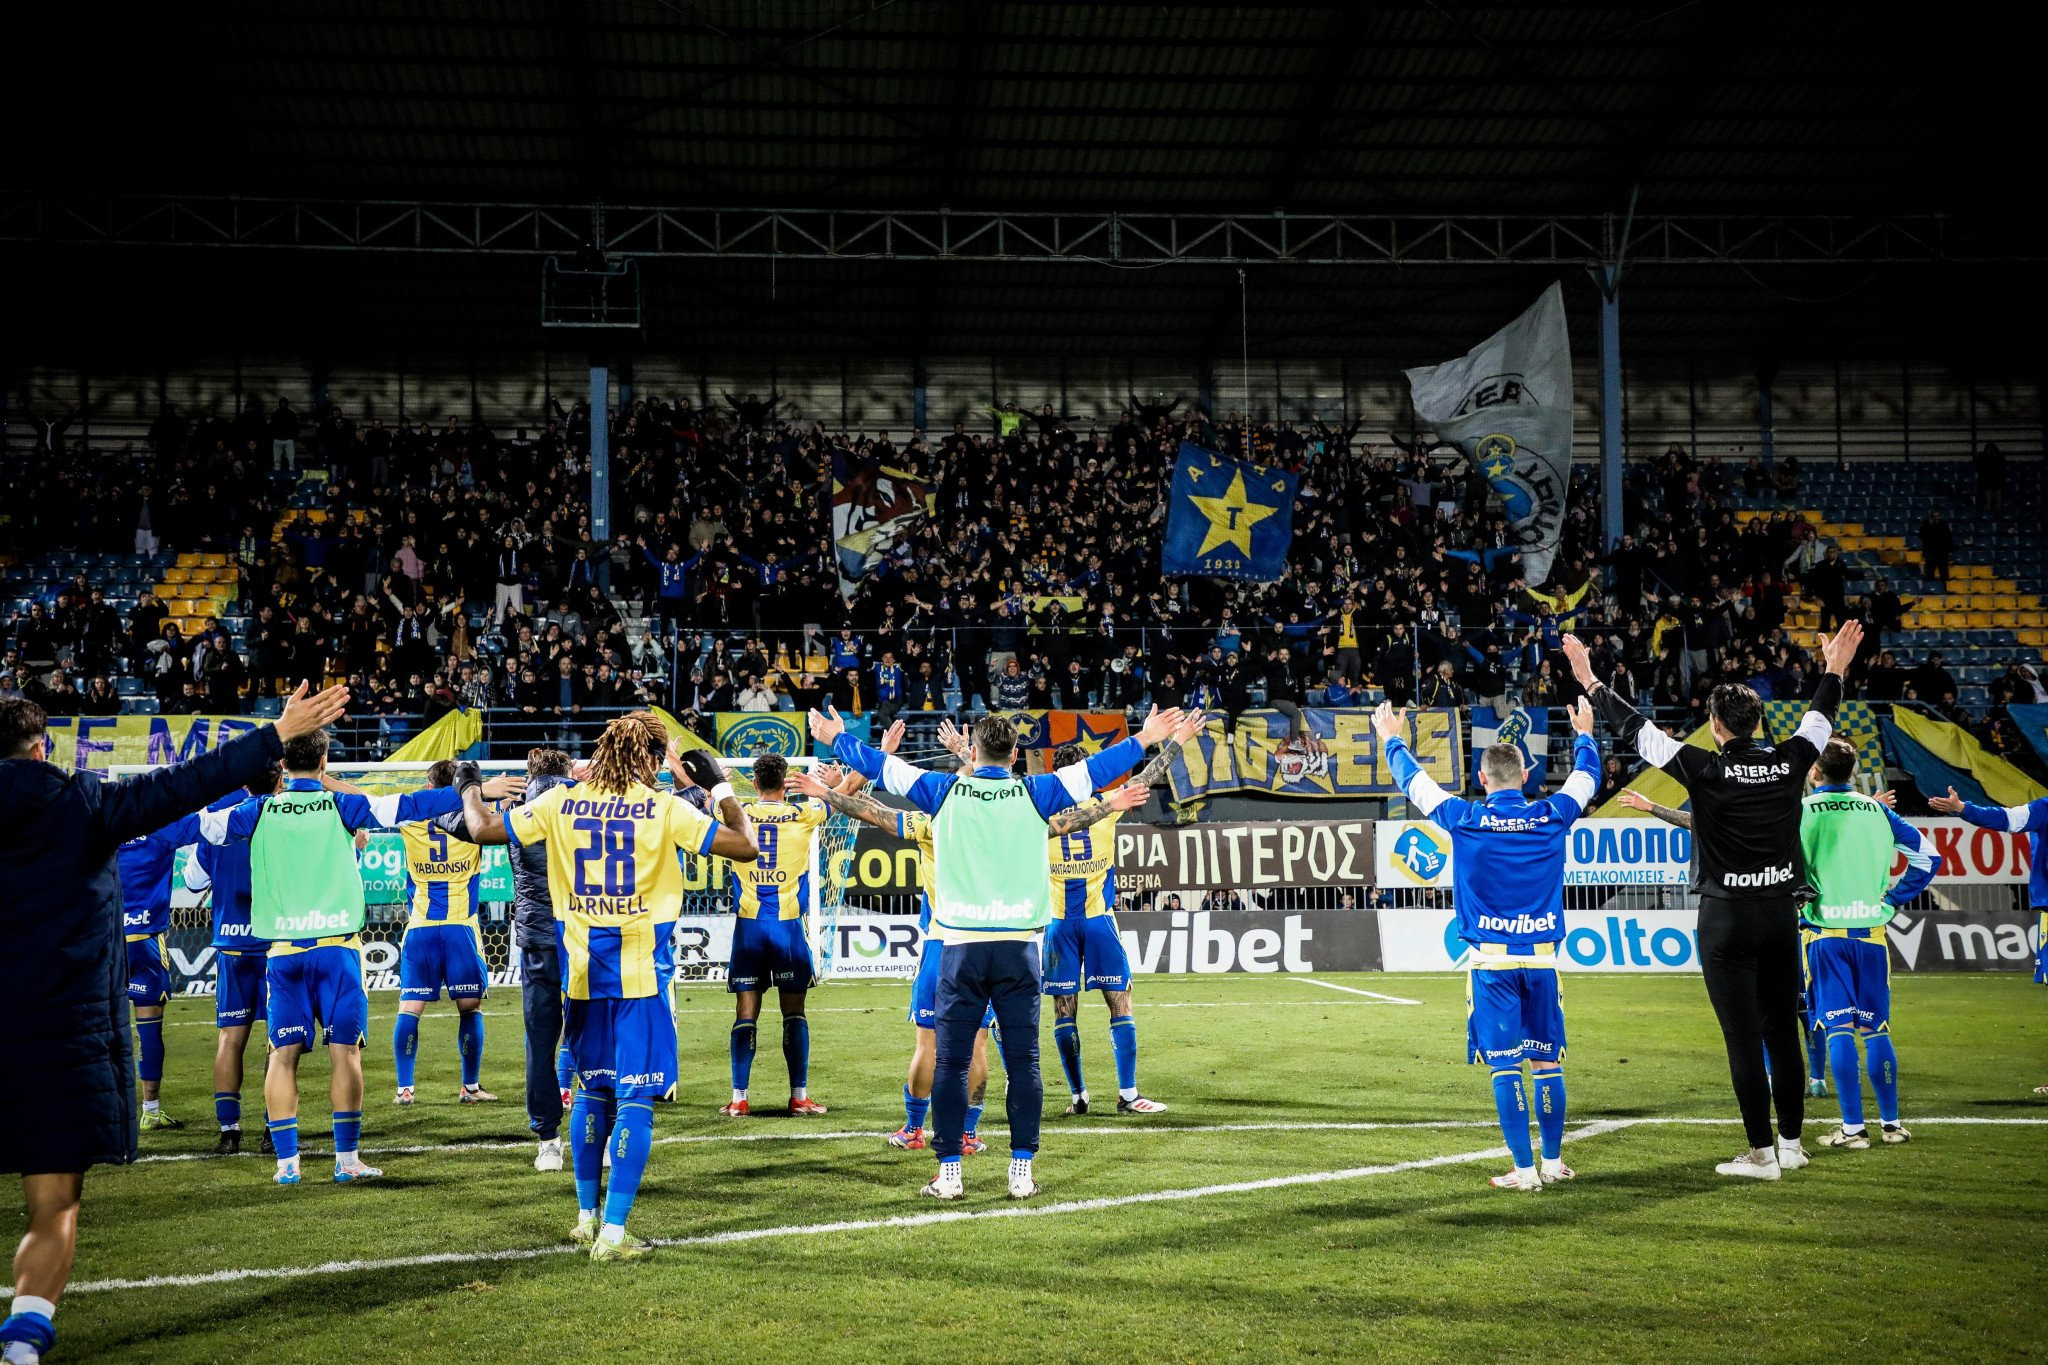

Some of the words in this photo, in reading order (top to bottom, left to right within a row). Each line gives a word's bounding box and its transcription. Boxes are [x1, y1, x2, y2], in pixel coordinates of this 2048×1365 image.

[1227, 507, 1243, 530] T
[1724, 762, 1790, 778] ASTERAS
[1737, 776, 1766, 784] TRIPOLIS
[954, 783, 1024, 801] macron
[560, 795, 656, 819] novibet
[1810, 800, 1877, 813] macron
[1525, 822, 1537, 830] F.C.
[428, 821, 448, 862] 5
[757, 824, 778, 869] 9
[1890, 827, 2031, 876] ΚΟΝ
[573, 818, 635, 896] 28
[1178, 824, 1364, 885] ΠΙΤΕΡΟΣ
[413, 860, 470, 874] YABLONSKI
[749, 870, 787, 883] NIKO
[1564, 870, 1665, 884] ΜΕΤΑΚΟΜΙΣΕΙΣ
[275, 909, 349, 931] novibet
[945, 899, 1033, 921] novibet
[1478, 912, 1557, 934] novibet
[837, 925, 919, 958] TOR
[1555, 917, 1702, 966] olto
[837, 965, 873, 973] ΟΜΙΛΟΣ
[1522, 1039, 1552, 1051] ΟΤΤΗΣ
